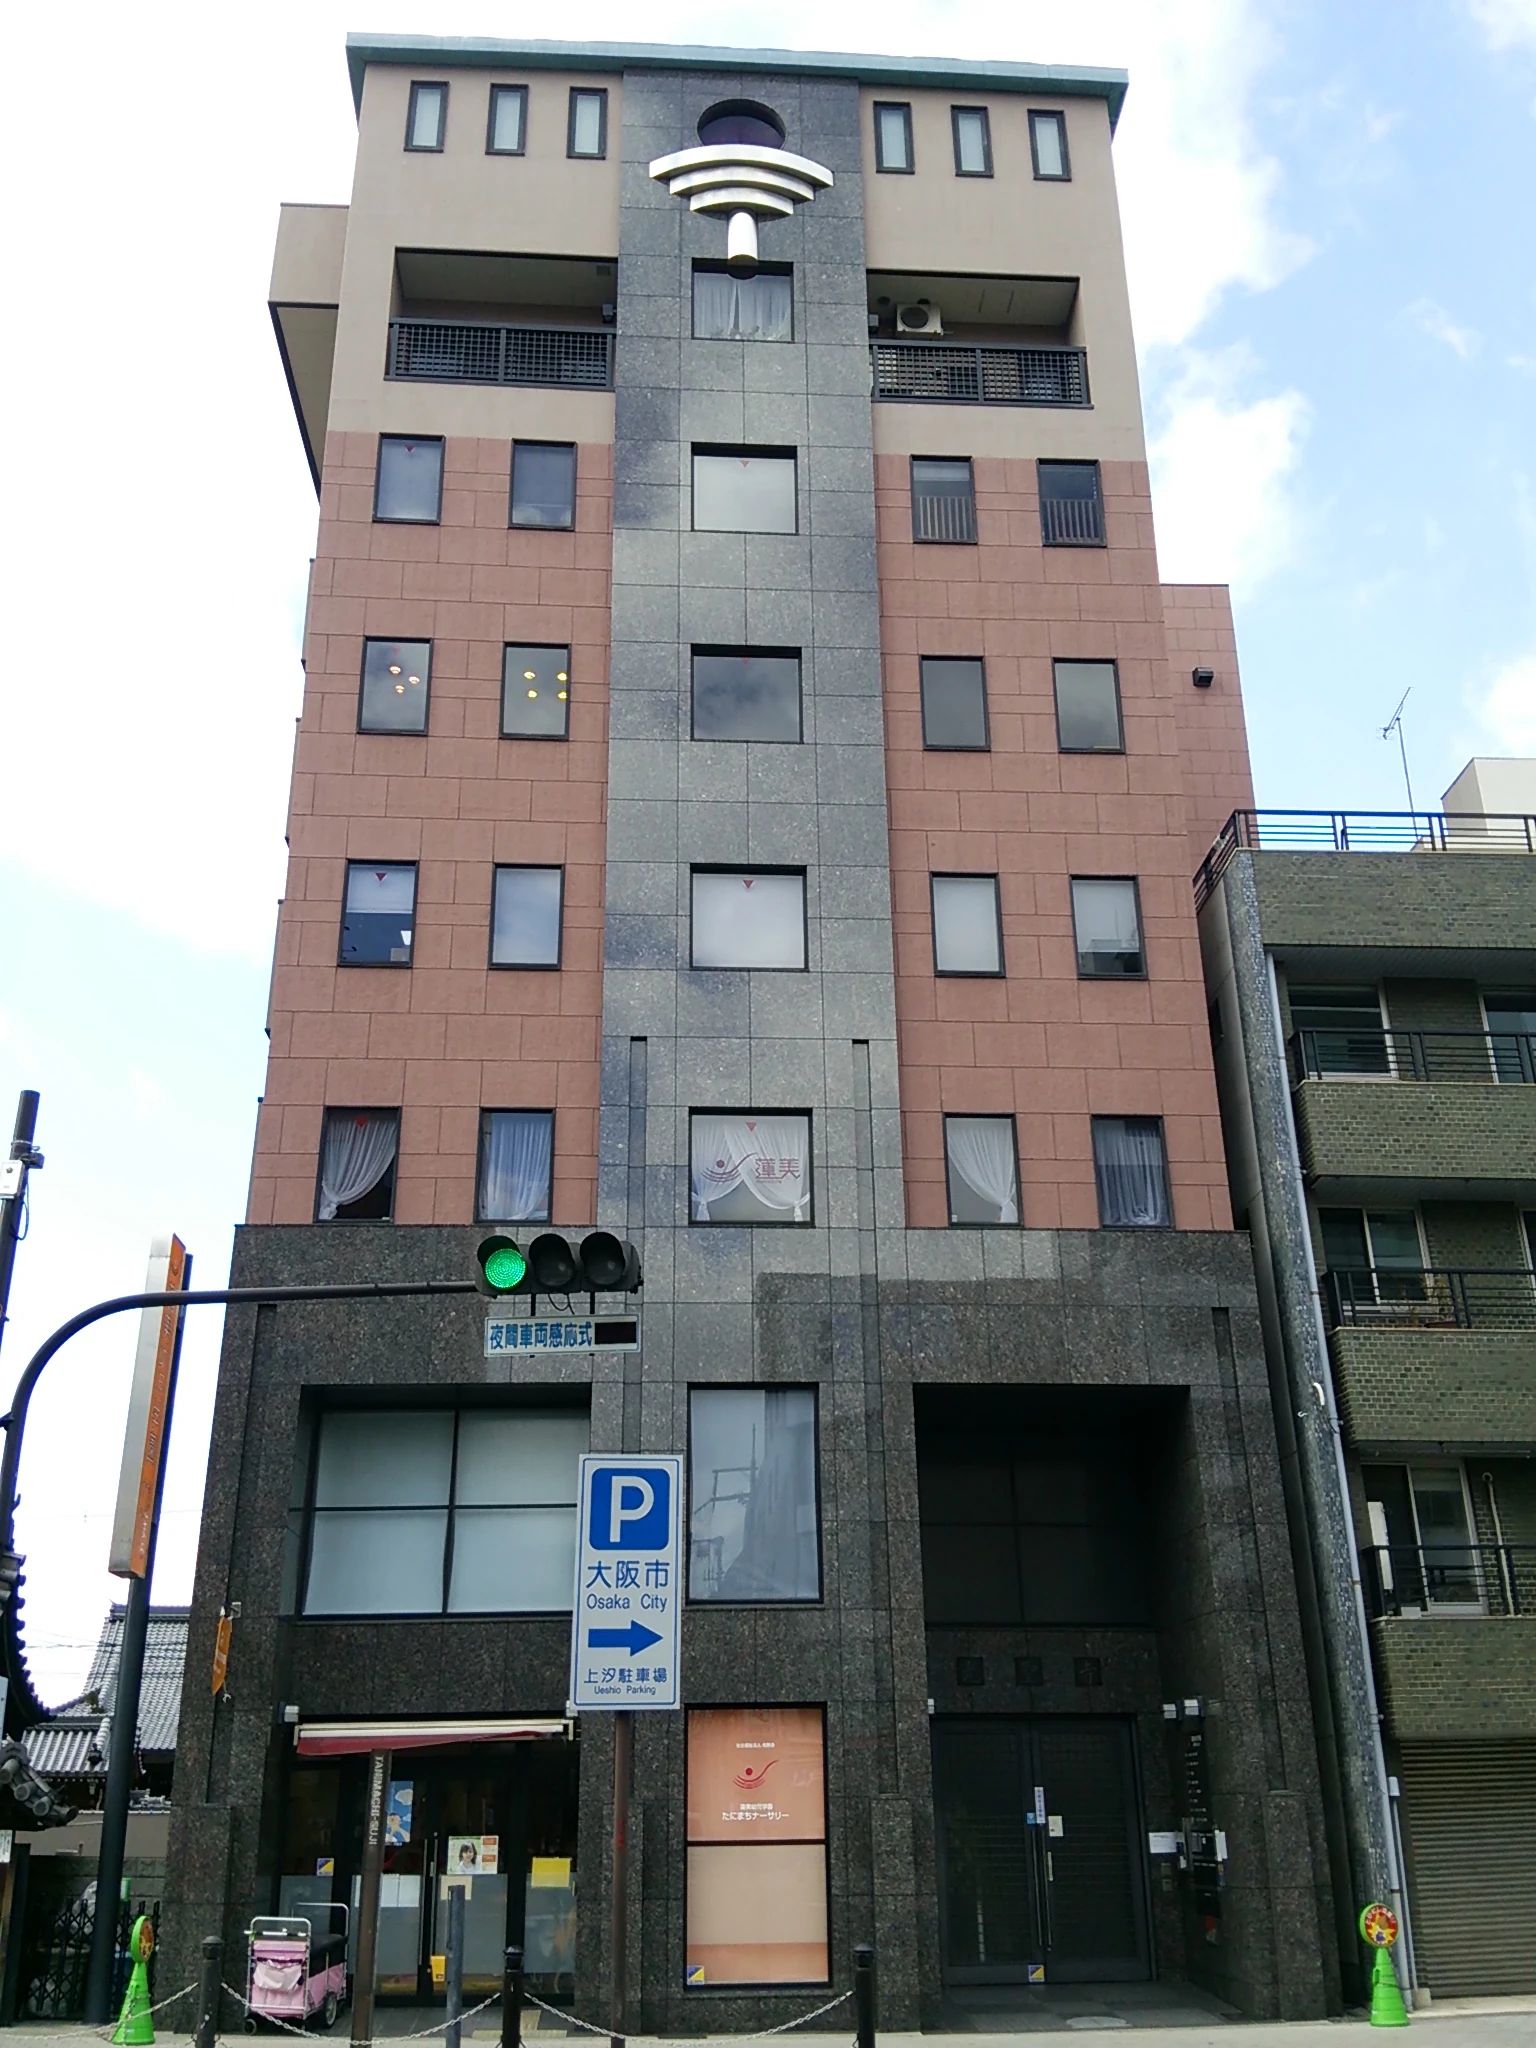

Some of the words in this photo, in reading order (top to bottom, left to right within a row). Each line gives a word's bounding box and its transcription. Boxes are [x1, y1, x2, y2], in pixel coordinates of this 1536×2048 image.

[490, 1321, 593, 1349] 夜間車両感応式
[609, 1475, 655, 1543] P
[586, 1559, 670, 1589] 大阪市
[586, 1593, 631, 1610] Osaka
[640, 1593, 668, 1613] City
[584, 1667, 668, 1684] 上汐駐車場
[594, 1686, 622, 1696] Ueshio
[626, 1685, 657, 1696] Parking
